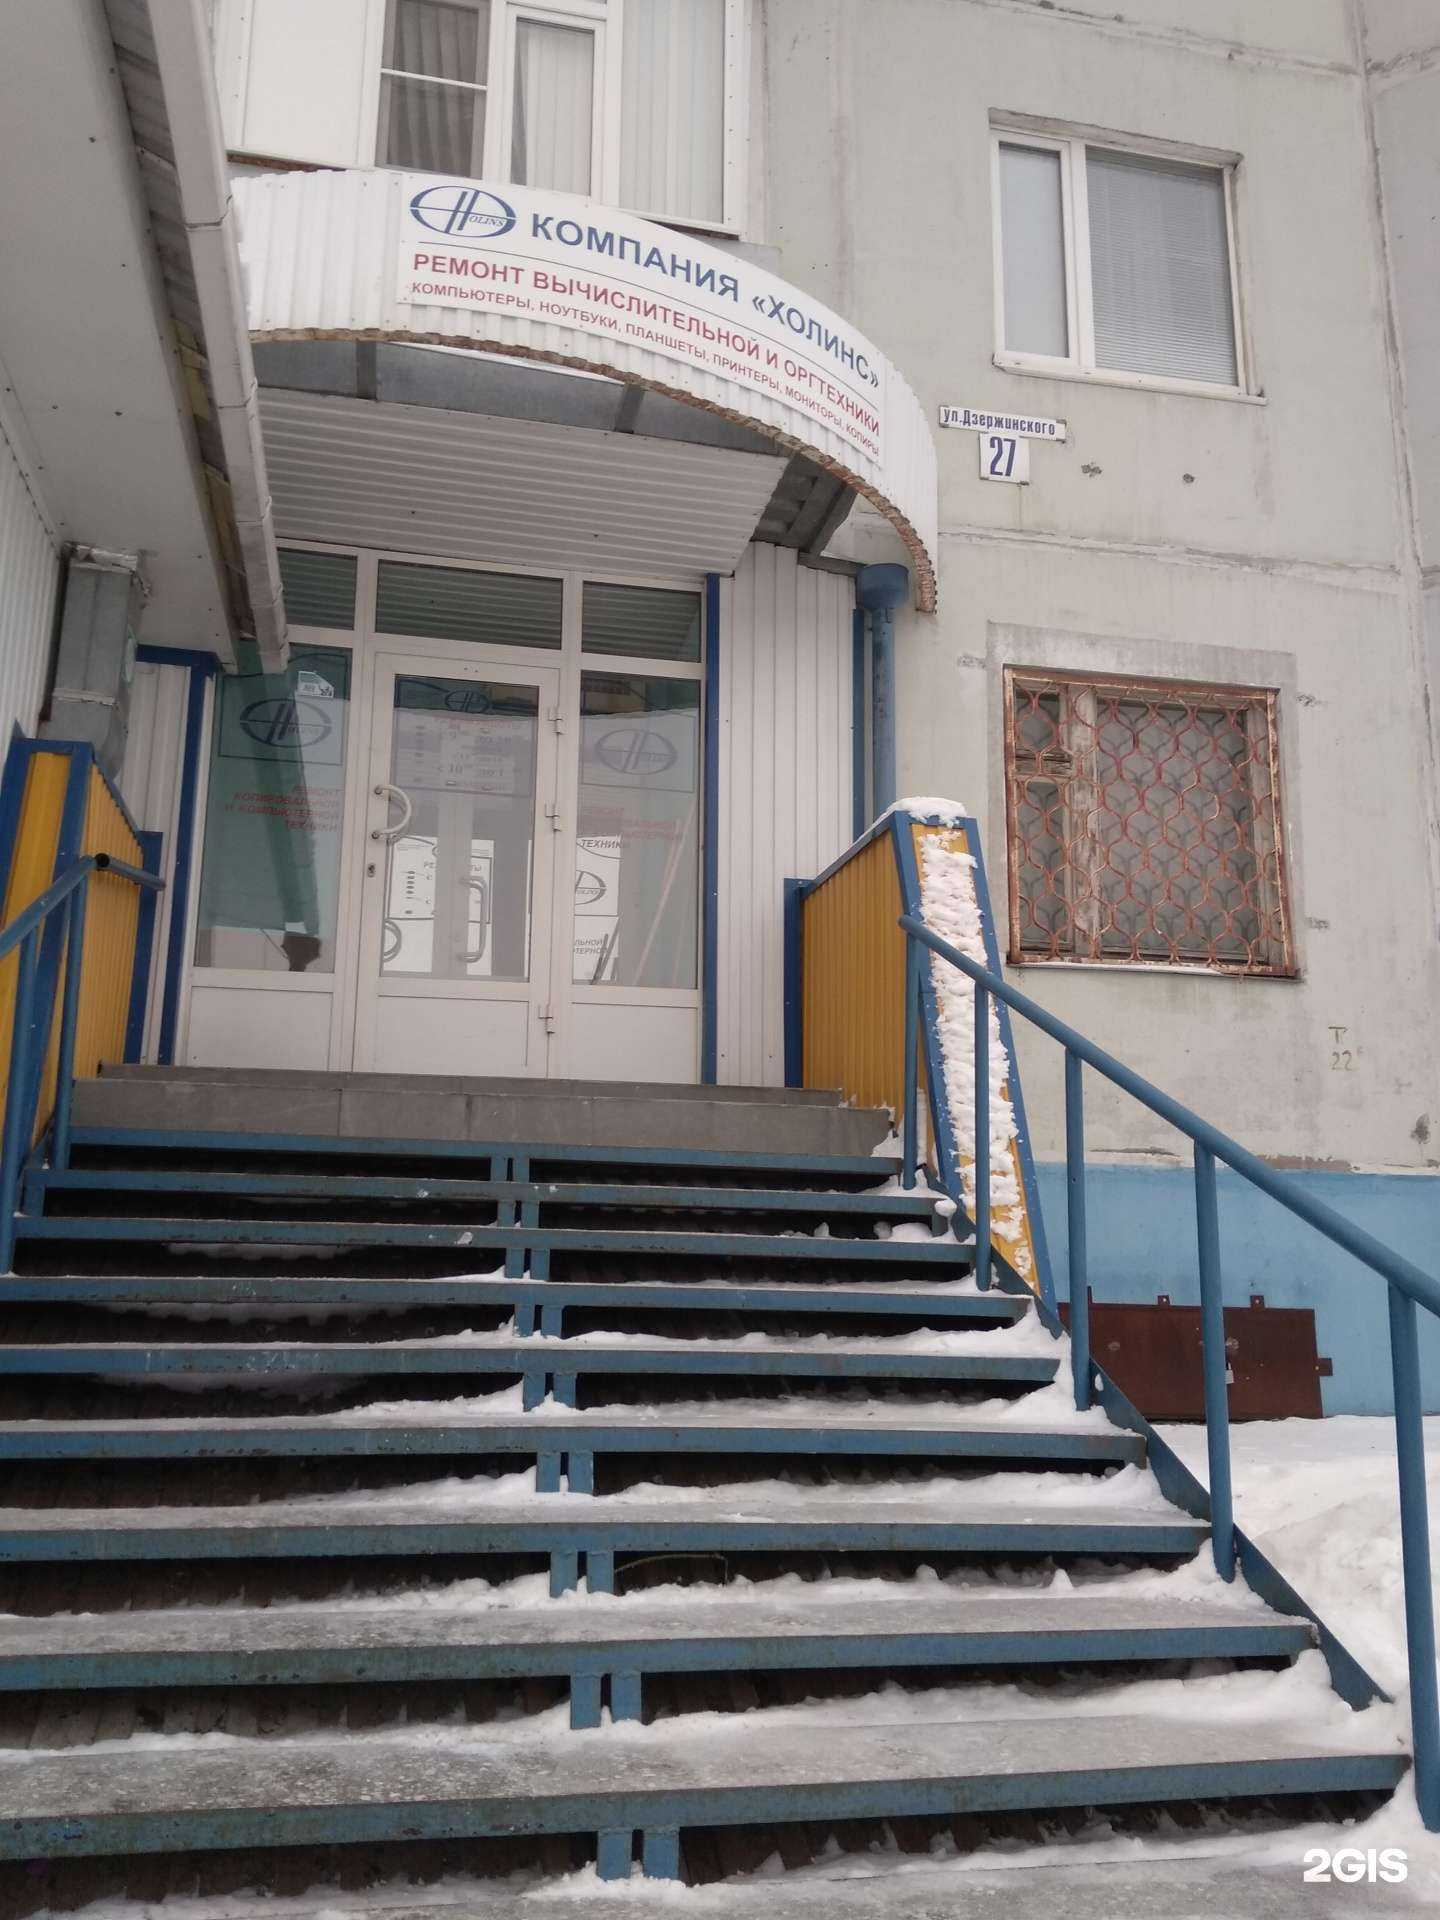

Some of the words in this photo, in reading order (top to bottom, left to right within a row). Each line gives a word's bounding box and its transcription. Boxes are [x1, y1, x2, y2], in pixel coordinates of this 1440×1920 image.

[412, 282, 535, 311] КОМПЬЮТЕРЫ,
[540, 301, 621, 333] НОУТБУКИ,
[626, 323, 709, 362] ПЛАНШЕТЫ,
[713, 354, 783, 394] ПРИНТЕРЫ,
[785, 385, 844, 431] МОНИТОРЫ,
[846, 423, 879, 457] КОПИРЫ
[413, 253, 525, 285] РЕМОНТ
[533, 271, 760, 360] ВЫЧИСЛИТЕЛЬНОЙ
[766, 348, 778, 369] И
[784, 359, 879, 437] ОРГТЕХНИКИ
[532, 213, 739, 302] КОМПАНИЯ
[752, 295, 879, 388] «ХОЛИНС»
[989, 436, 1017, 477] 27
[1332, 1050, 1352, 1071] 22
